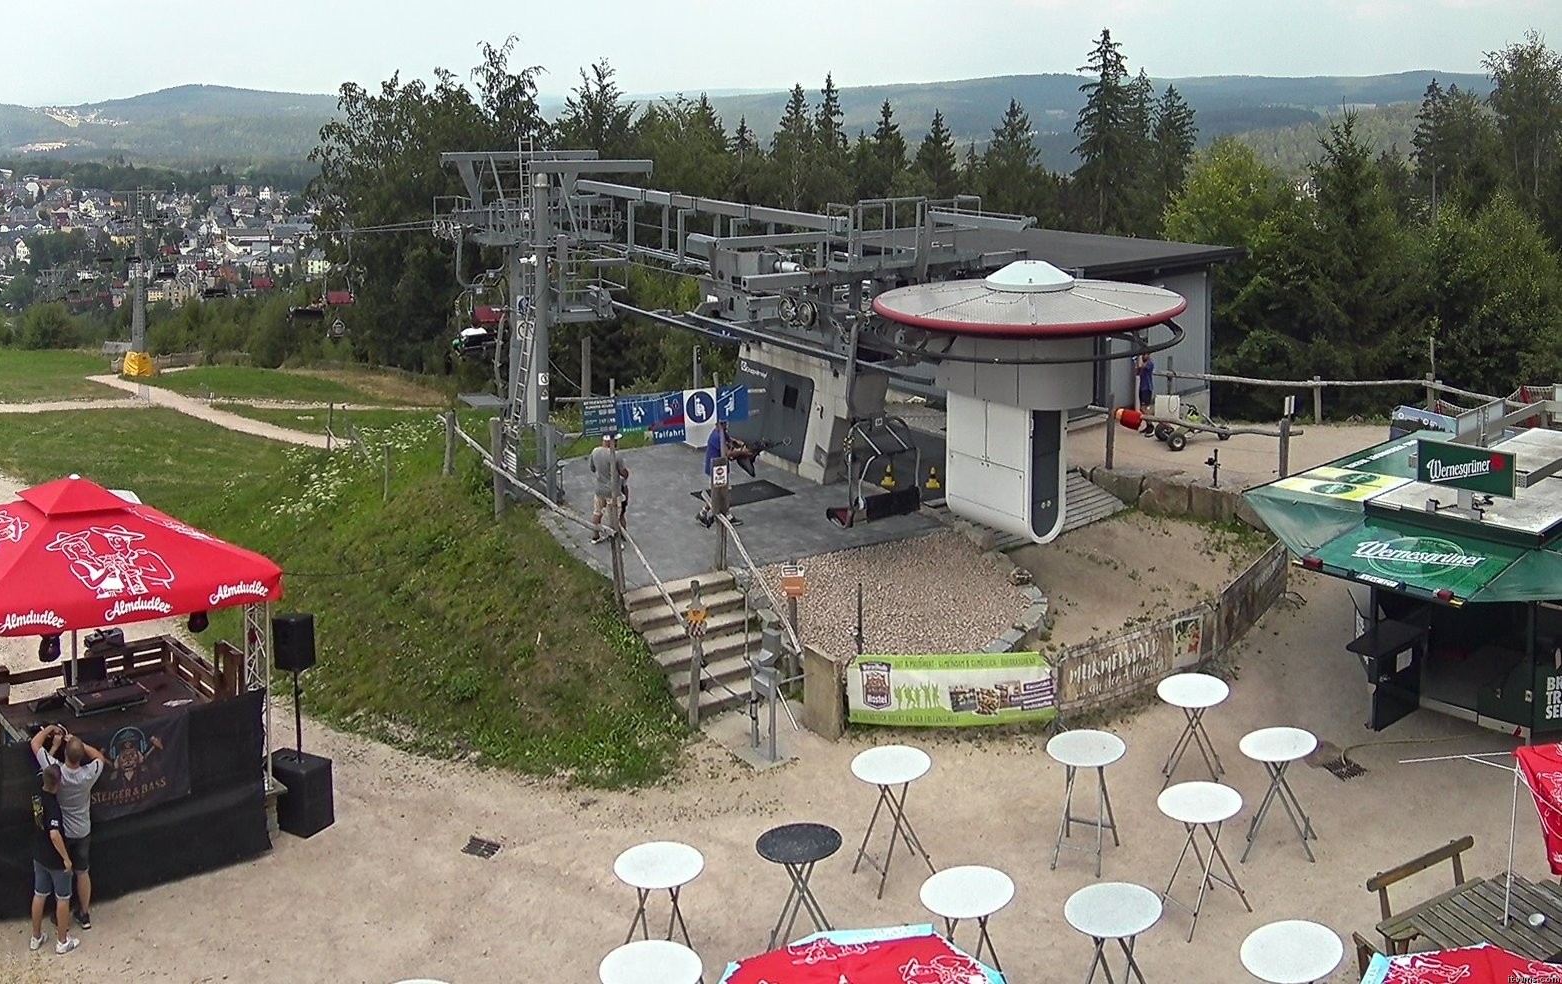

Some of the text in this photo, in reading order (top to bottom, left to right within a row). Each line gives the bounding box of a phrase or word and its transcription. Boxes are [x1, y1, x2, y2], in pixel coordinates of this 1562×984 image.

[654, 429, 684, 439] Talfahrt
[1427, 458, 1492, 481] Wernesgrüner
[1353, 541, 1486, 567] Wernesgrüner
[209, 581, 268, 605] Almdudler
[105, 597, 173, 621] Almdudler
[141, 776, 167, 793] BASS
